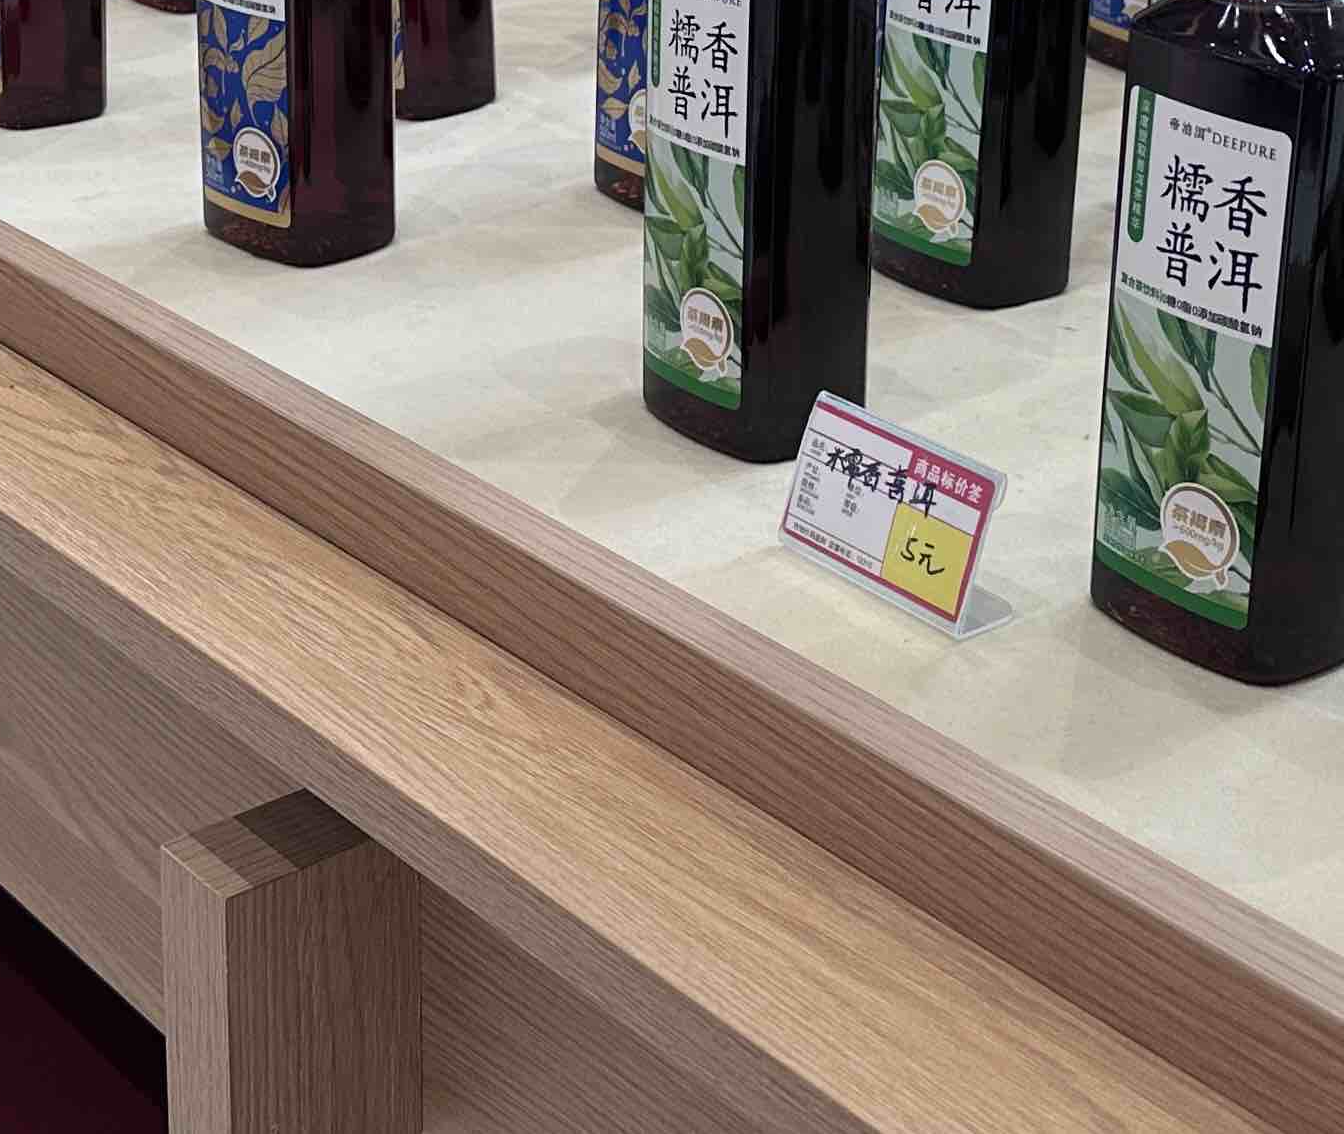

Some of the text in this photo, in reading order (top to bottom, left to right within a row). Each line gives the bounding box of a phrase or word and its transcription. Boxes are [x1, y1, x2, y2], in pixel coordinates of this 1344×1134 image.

[668, 8, 739, 75] 糯香
[666, 65, 739, 140] 普洱
[1212, 131, 1278, 162] DEEPURE
[1159, 154, 1269, 238] 糯香
[1155, 221, 1264, 315] 普洱
[913, 458, 984, 504] 商品标价签
[900, 537, 945, 576] 5元
